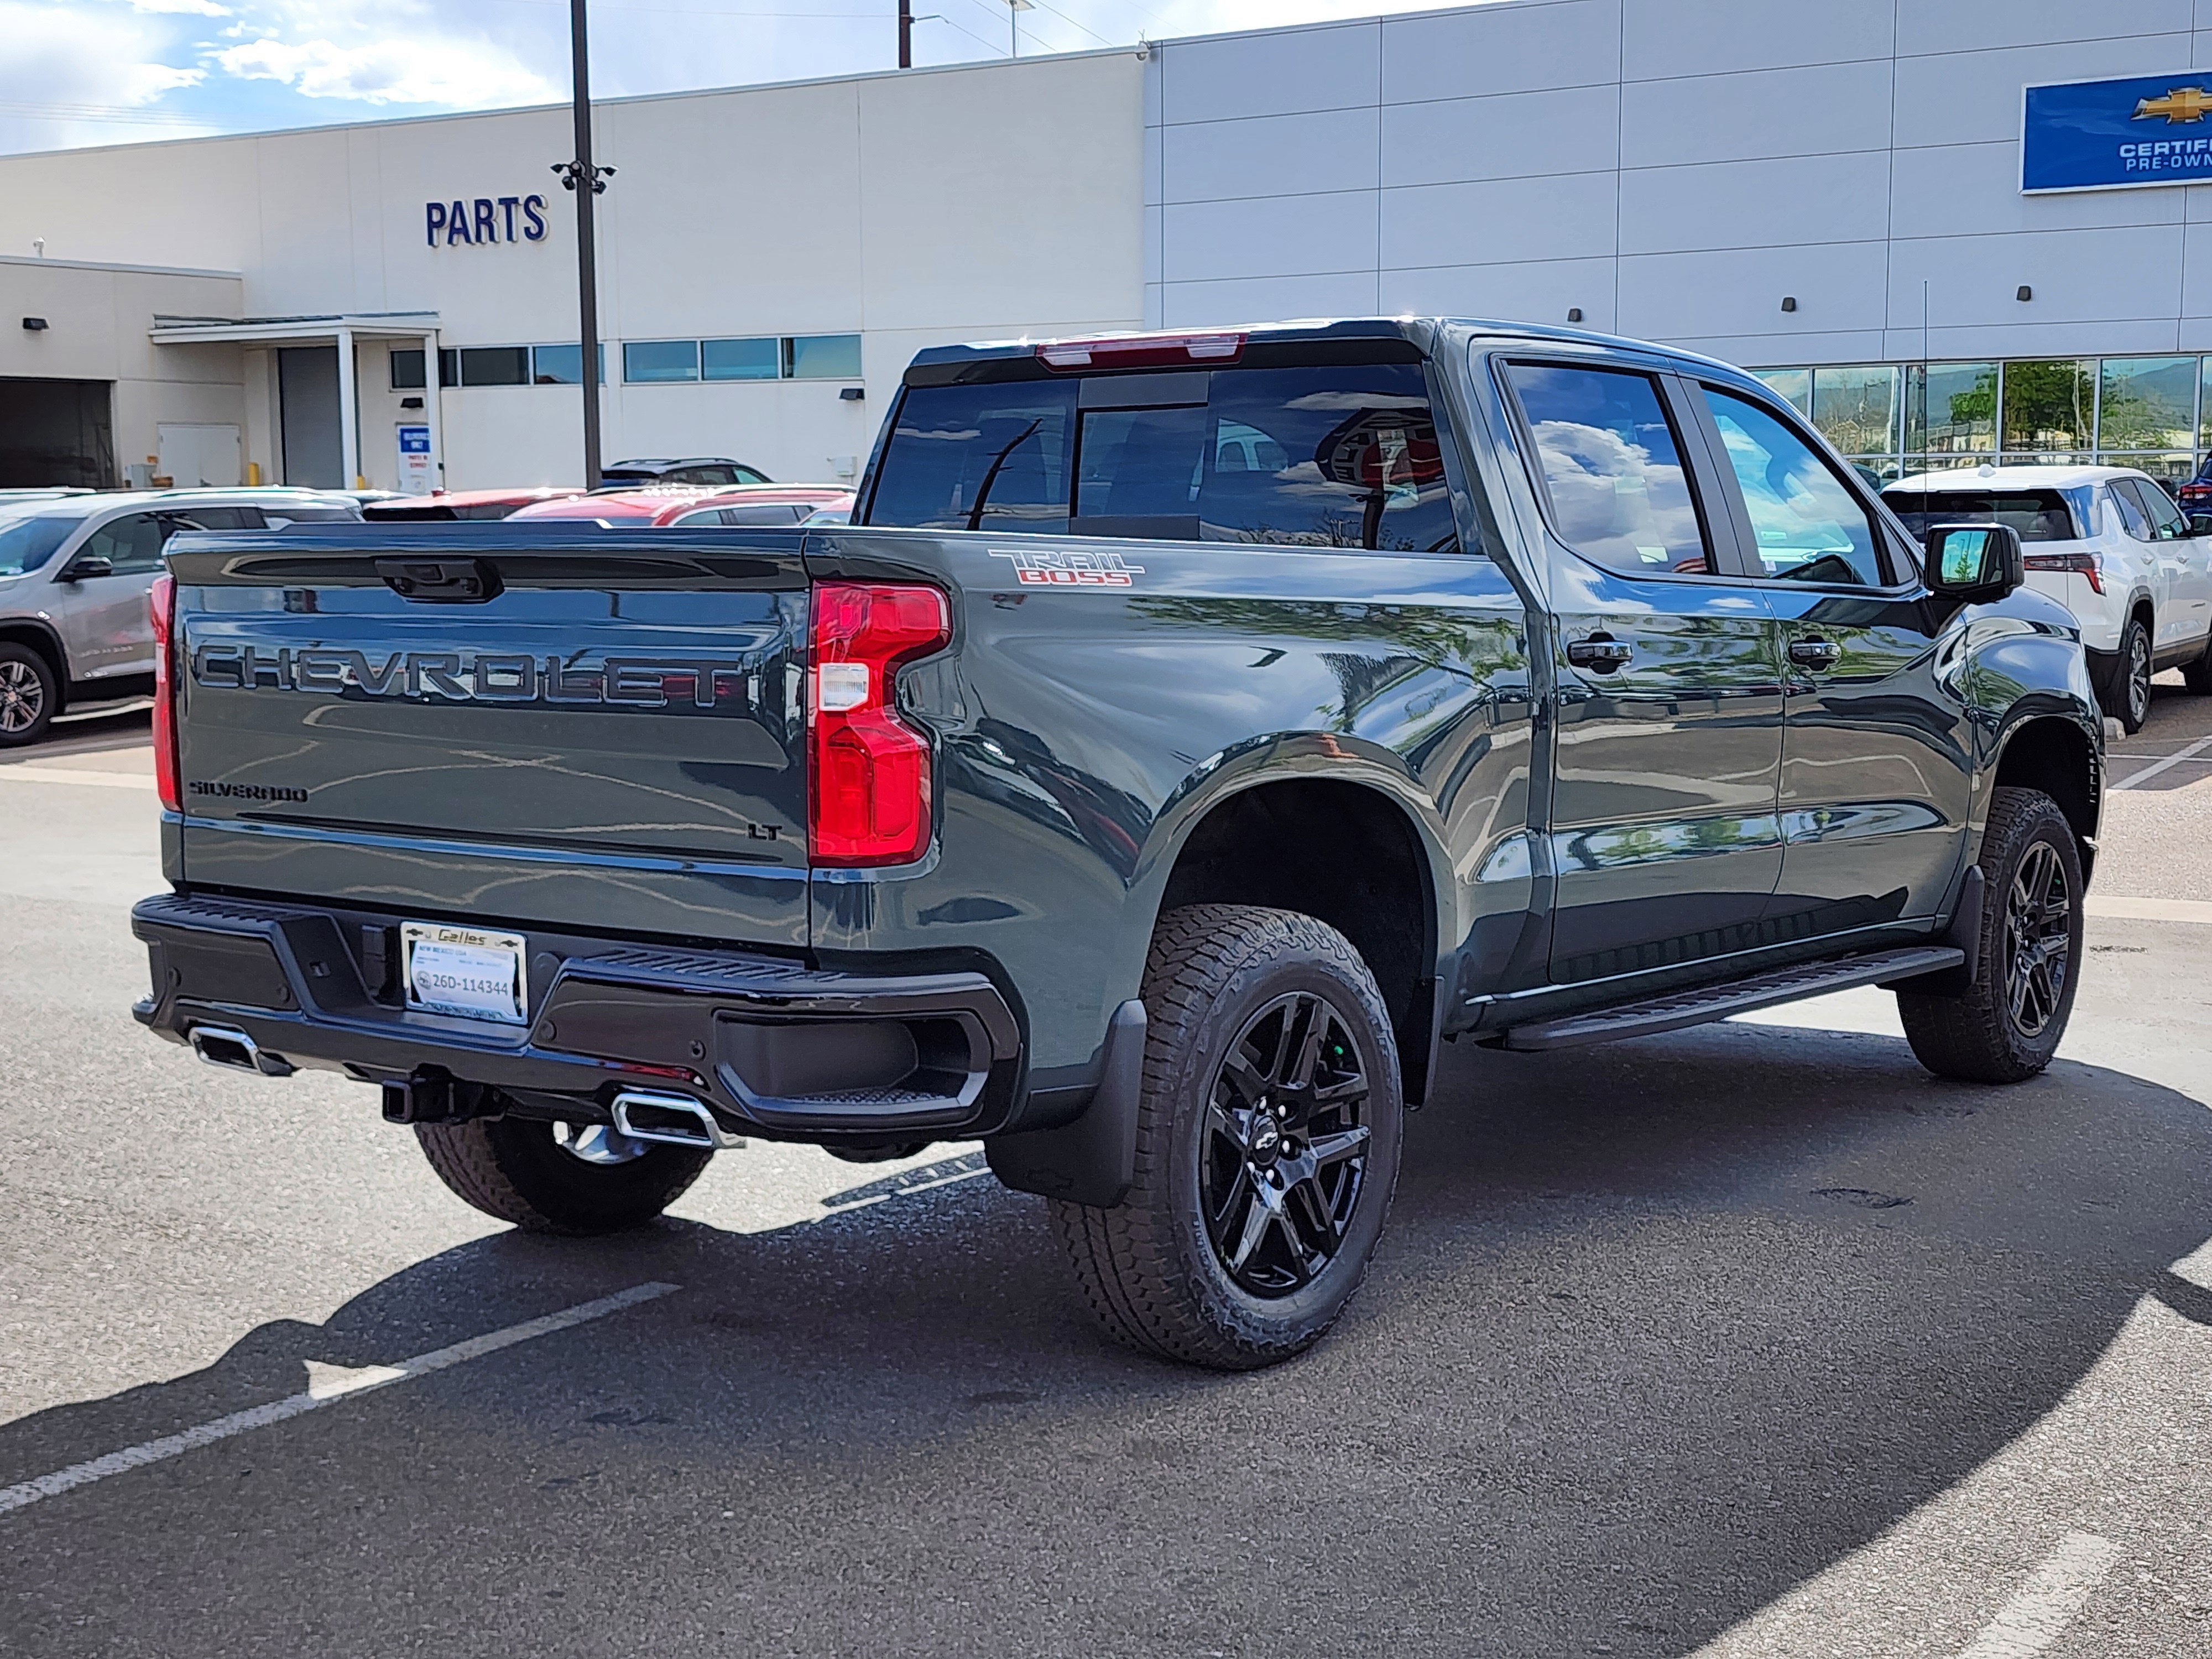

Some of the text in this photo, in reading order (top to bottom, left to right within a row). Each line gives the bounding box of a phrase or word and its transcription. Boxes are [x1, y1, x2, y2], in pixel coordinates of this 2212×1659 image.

[426, 195, 546, 247] PARTS
[988, 549, 1145, 574] TRAIL
[1016, 568, 1133, 586] BOSS
[196, 645, 742, 707] CHEVROLET
[189, 780, 308, 802] SILVERADO
[748, 824, 782, 840] LT
[438, 929, 488, 946] Galles
[432, 974, 508, 995] 26D-114344
